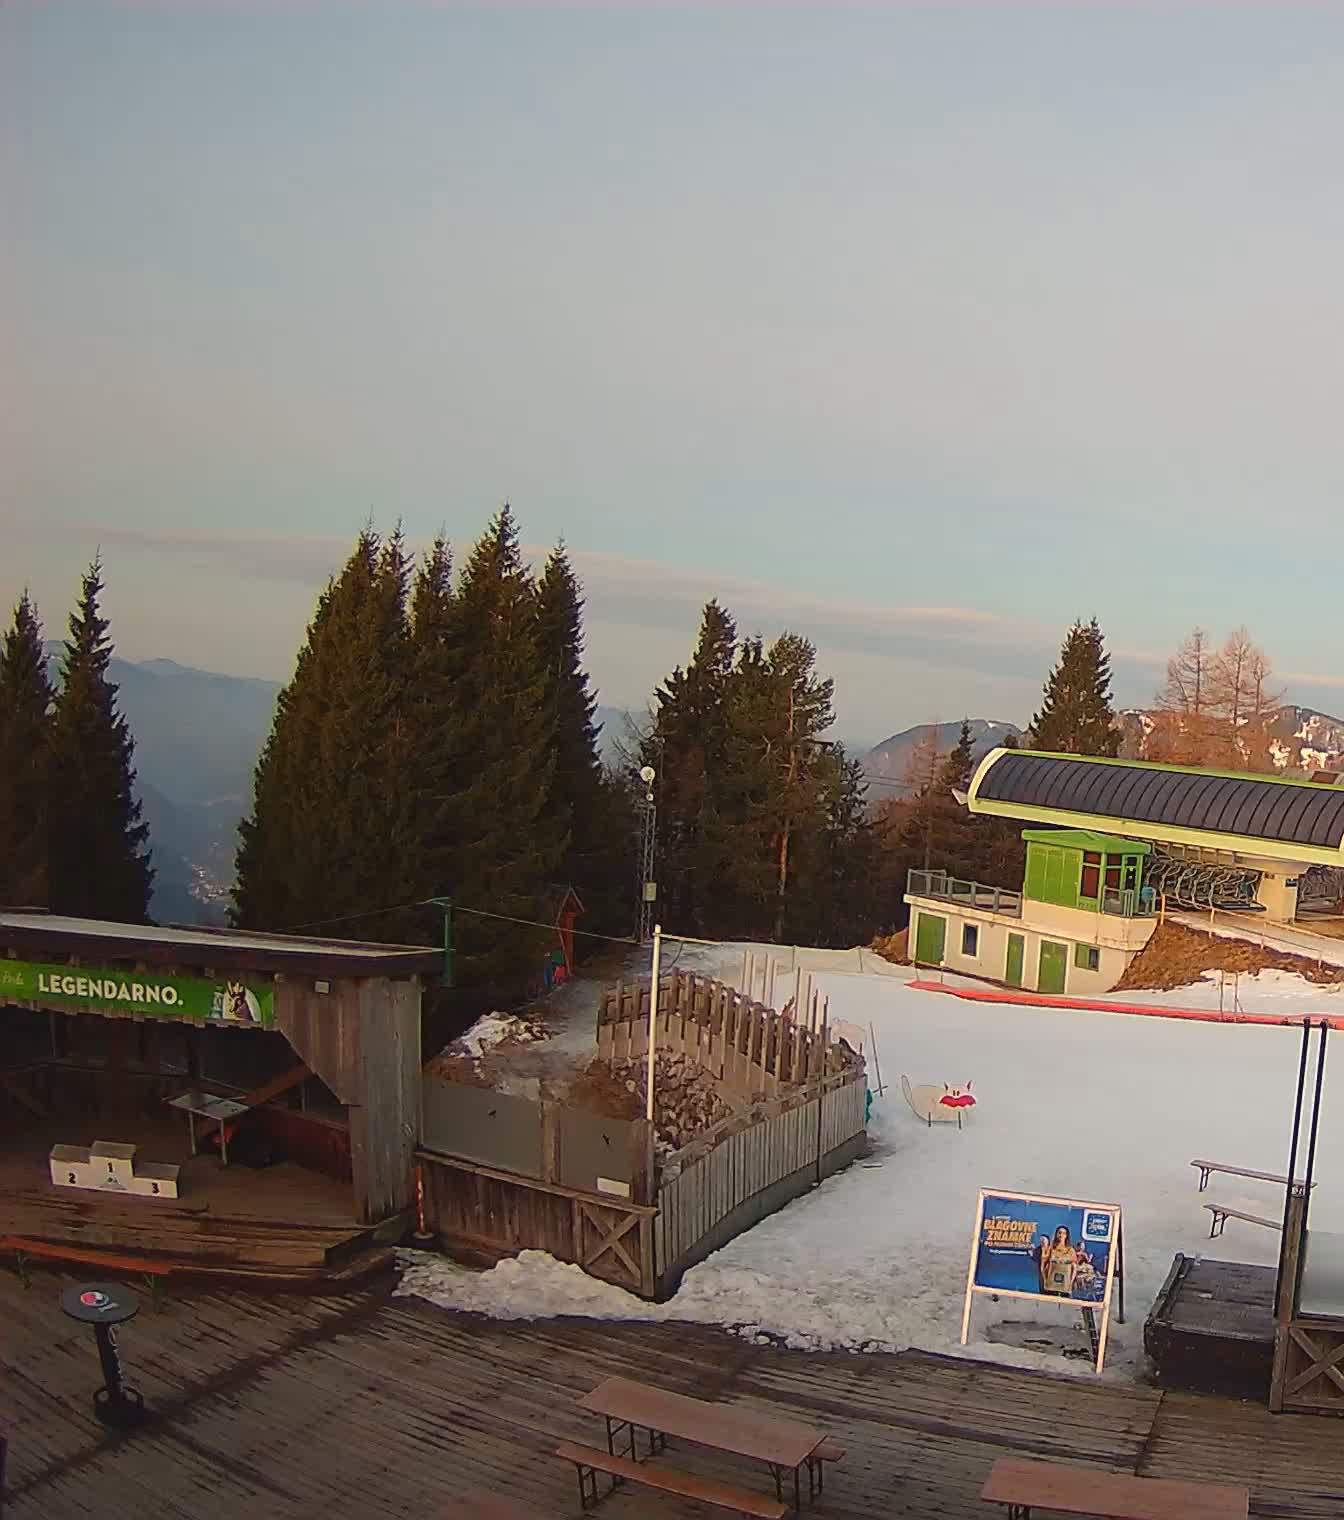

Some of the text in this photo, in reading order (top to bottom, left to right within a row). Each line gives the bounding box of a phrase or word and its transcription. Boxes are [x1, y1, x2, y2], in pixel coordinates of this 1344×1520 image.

[38, 973, 184, 1006] LEGENDARNO.
[107, 1162, 113, 1172] 1
[68, 1172, 76, 1184] 2
[151, 1182, 160, 1193] 3
